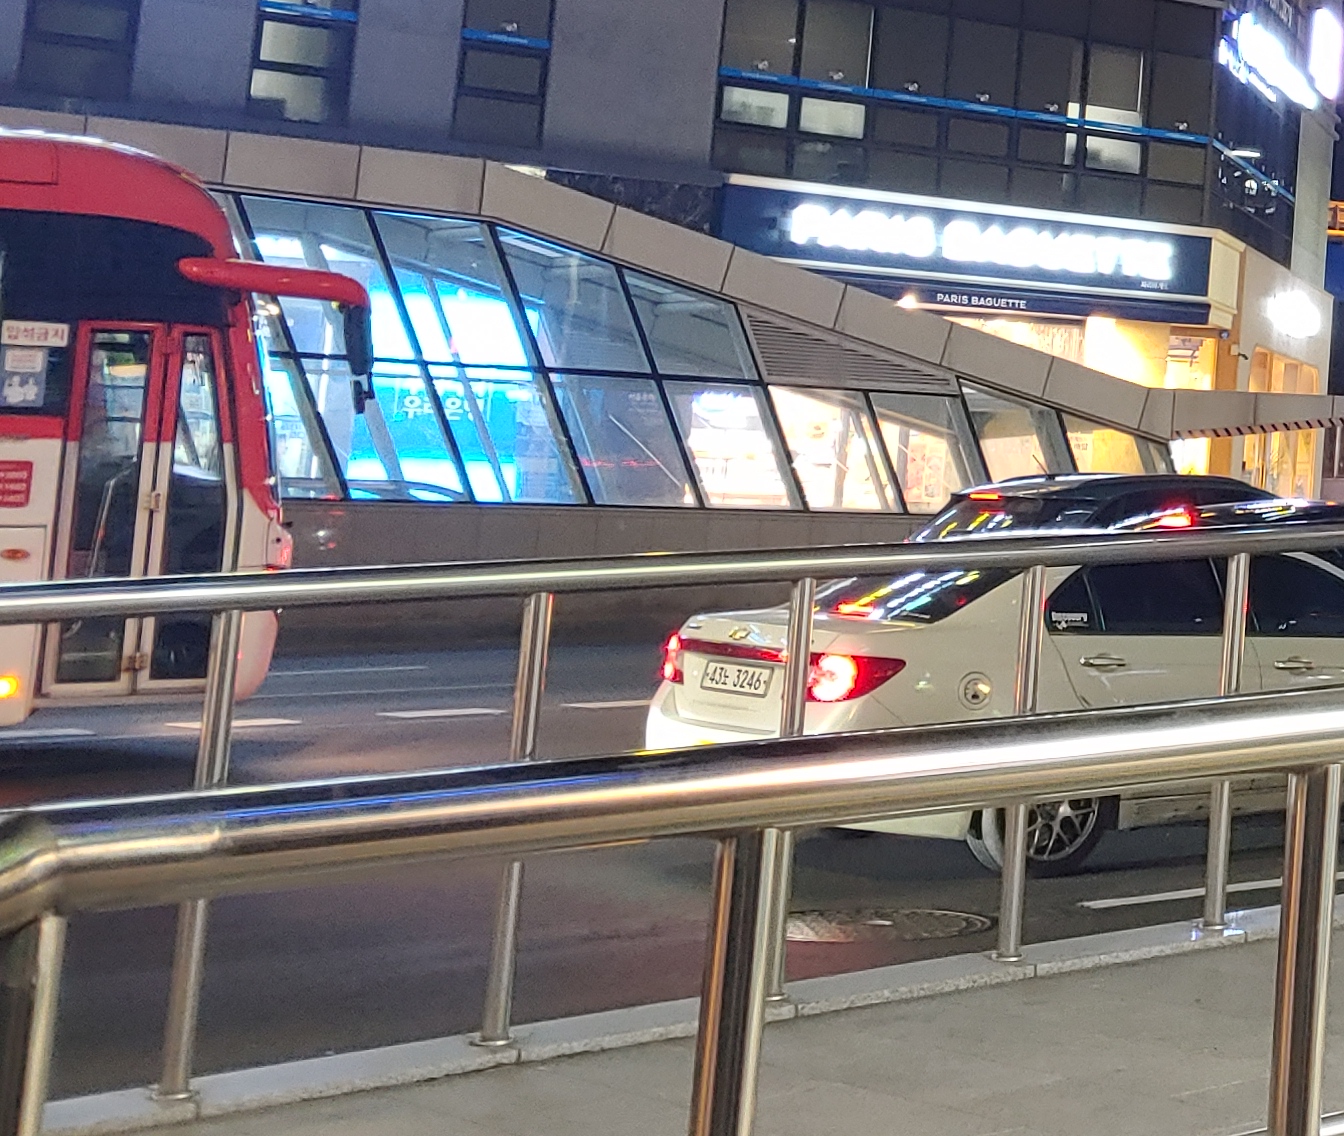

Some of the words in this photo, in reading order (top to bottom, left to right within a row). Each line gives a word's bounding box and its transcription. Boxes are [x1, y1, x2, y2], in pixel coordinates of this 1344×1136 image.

[936, 293, 969, 304] PARIS
[971, 296, 1027, 309] BAGUETTE
[732, 669, 763, 691] 3246
